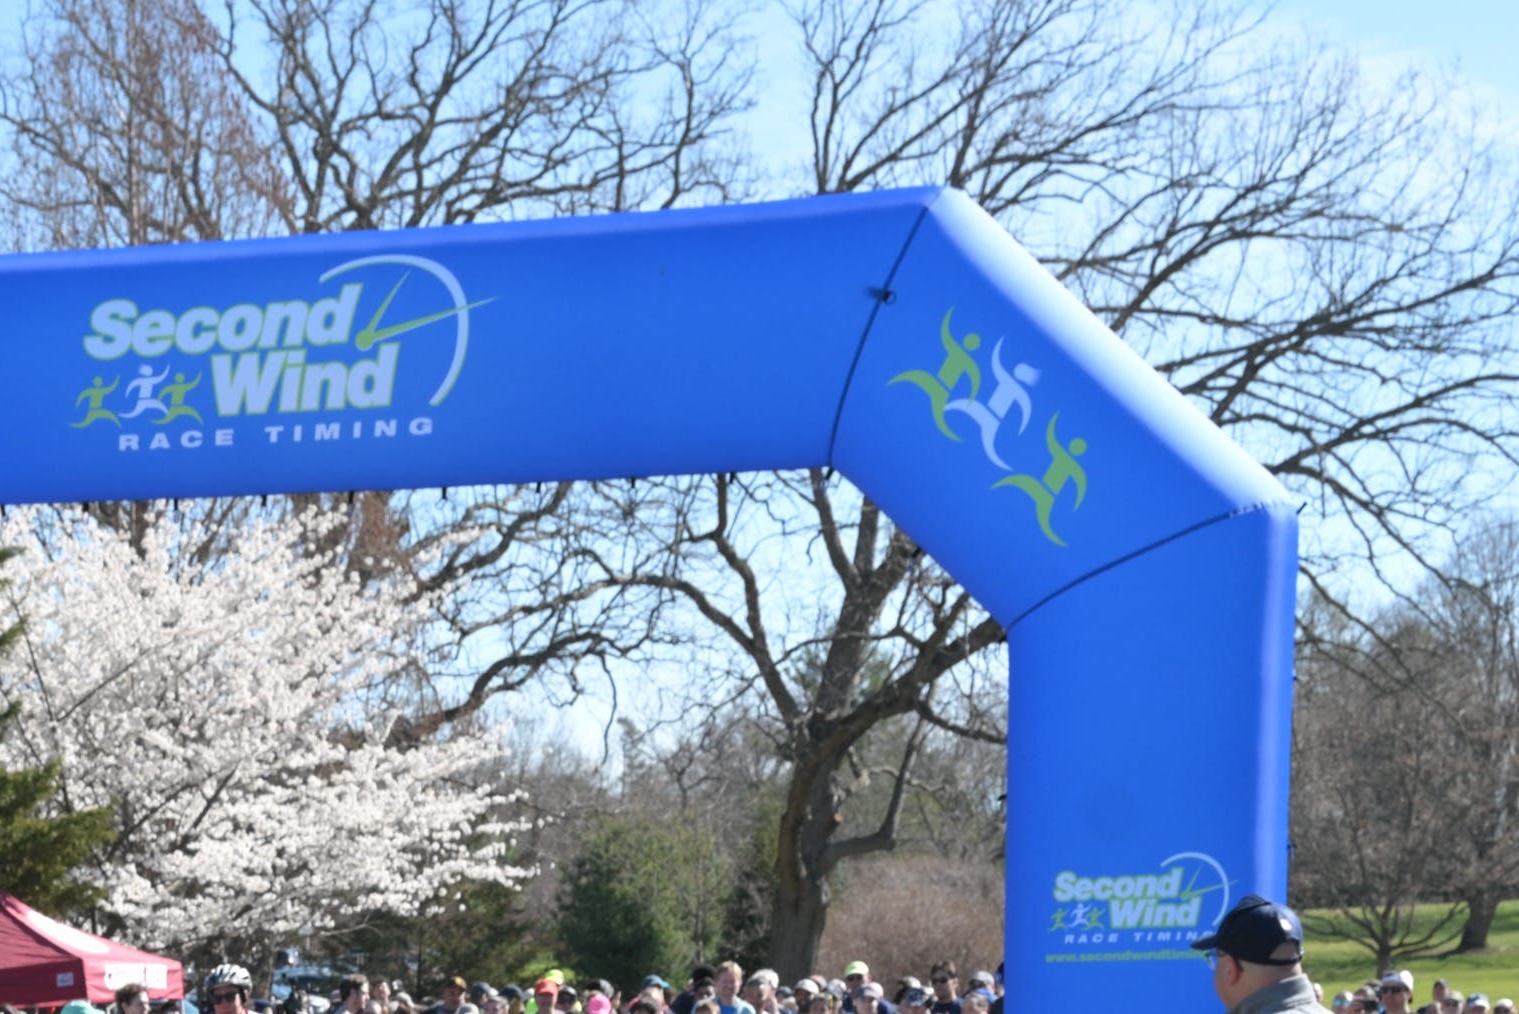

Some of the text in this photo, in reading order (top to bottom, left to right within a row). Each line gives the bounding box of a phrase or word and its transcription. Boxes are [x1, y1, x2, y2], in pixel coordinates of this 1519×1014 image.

[84, 281, 364, 361] Second
[210, 342, 401, 417] Wind
[118, 416, 434, 451] RACE TIMING
[1053, 866, 1184, 902] Second
[1109, 896, 1202, 929] Wind
[1064, 933, 1119, 944] RACE
